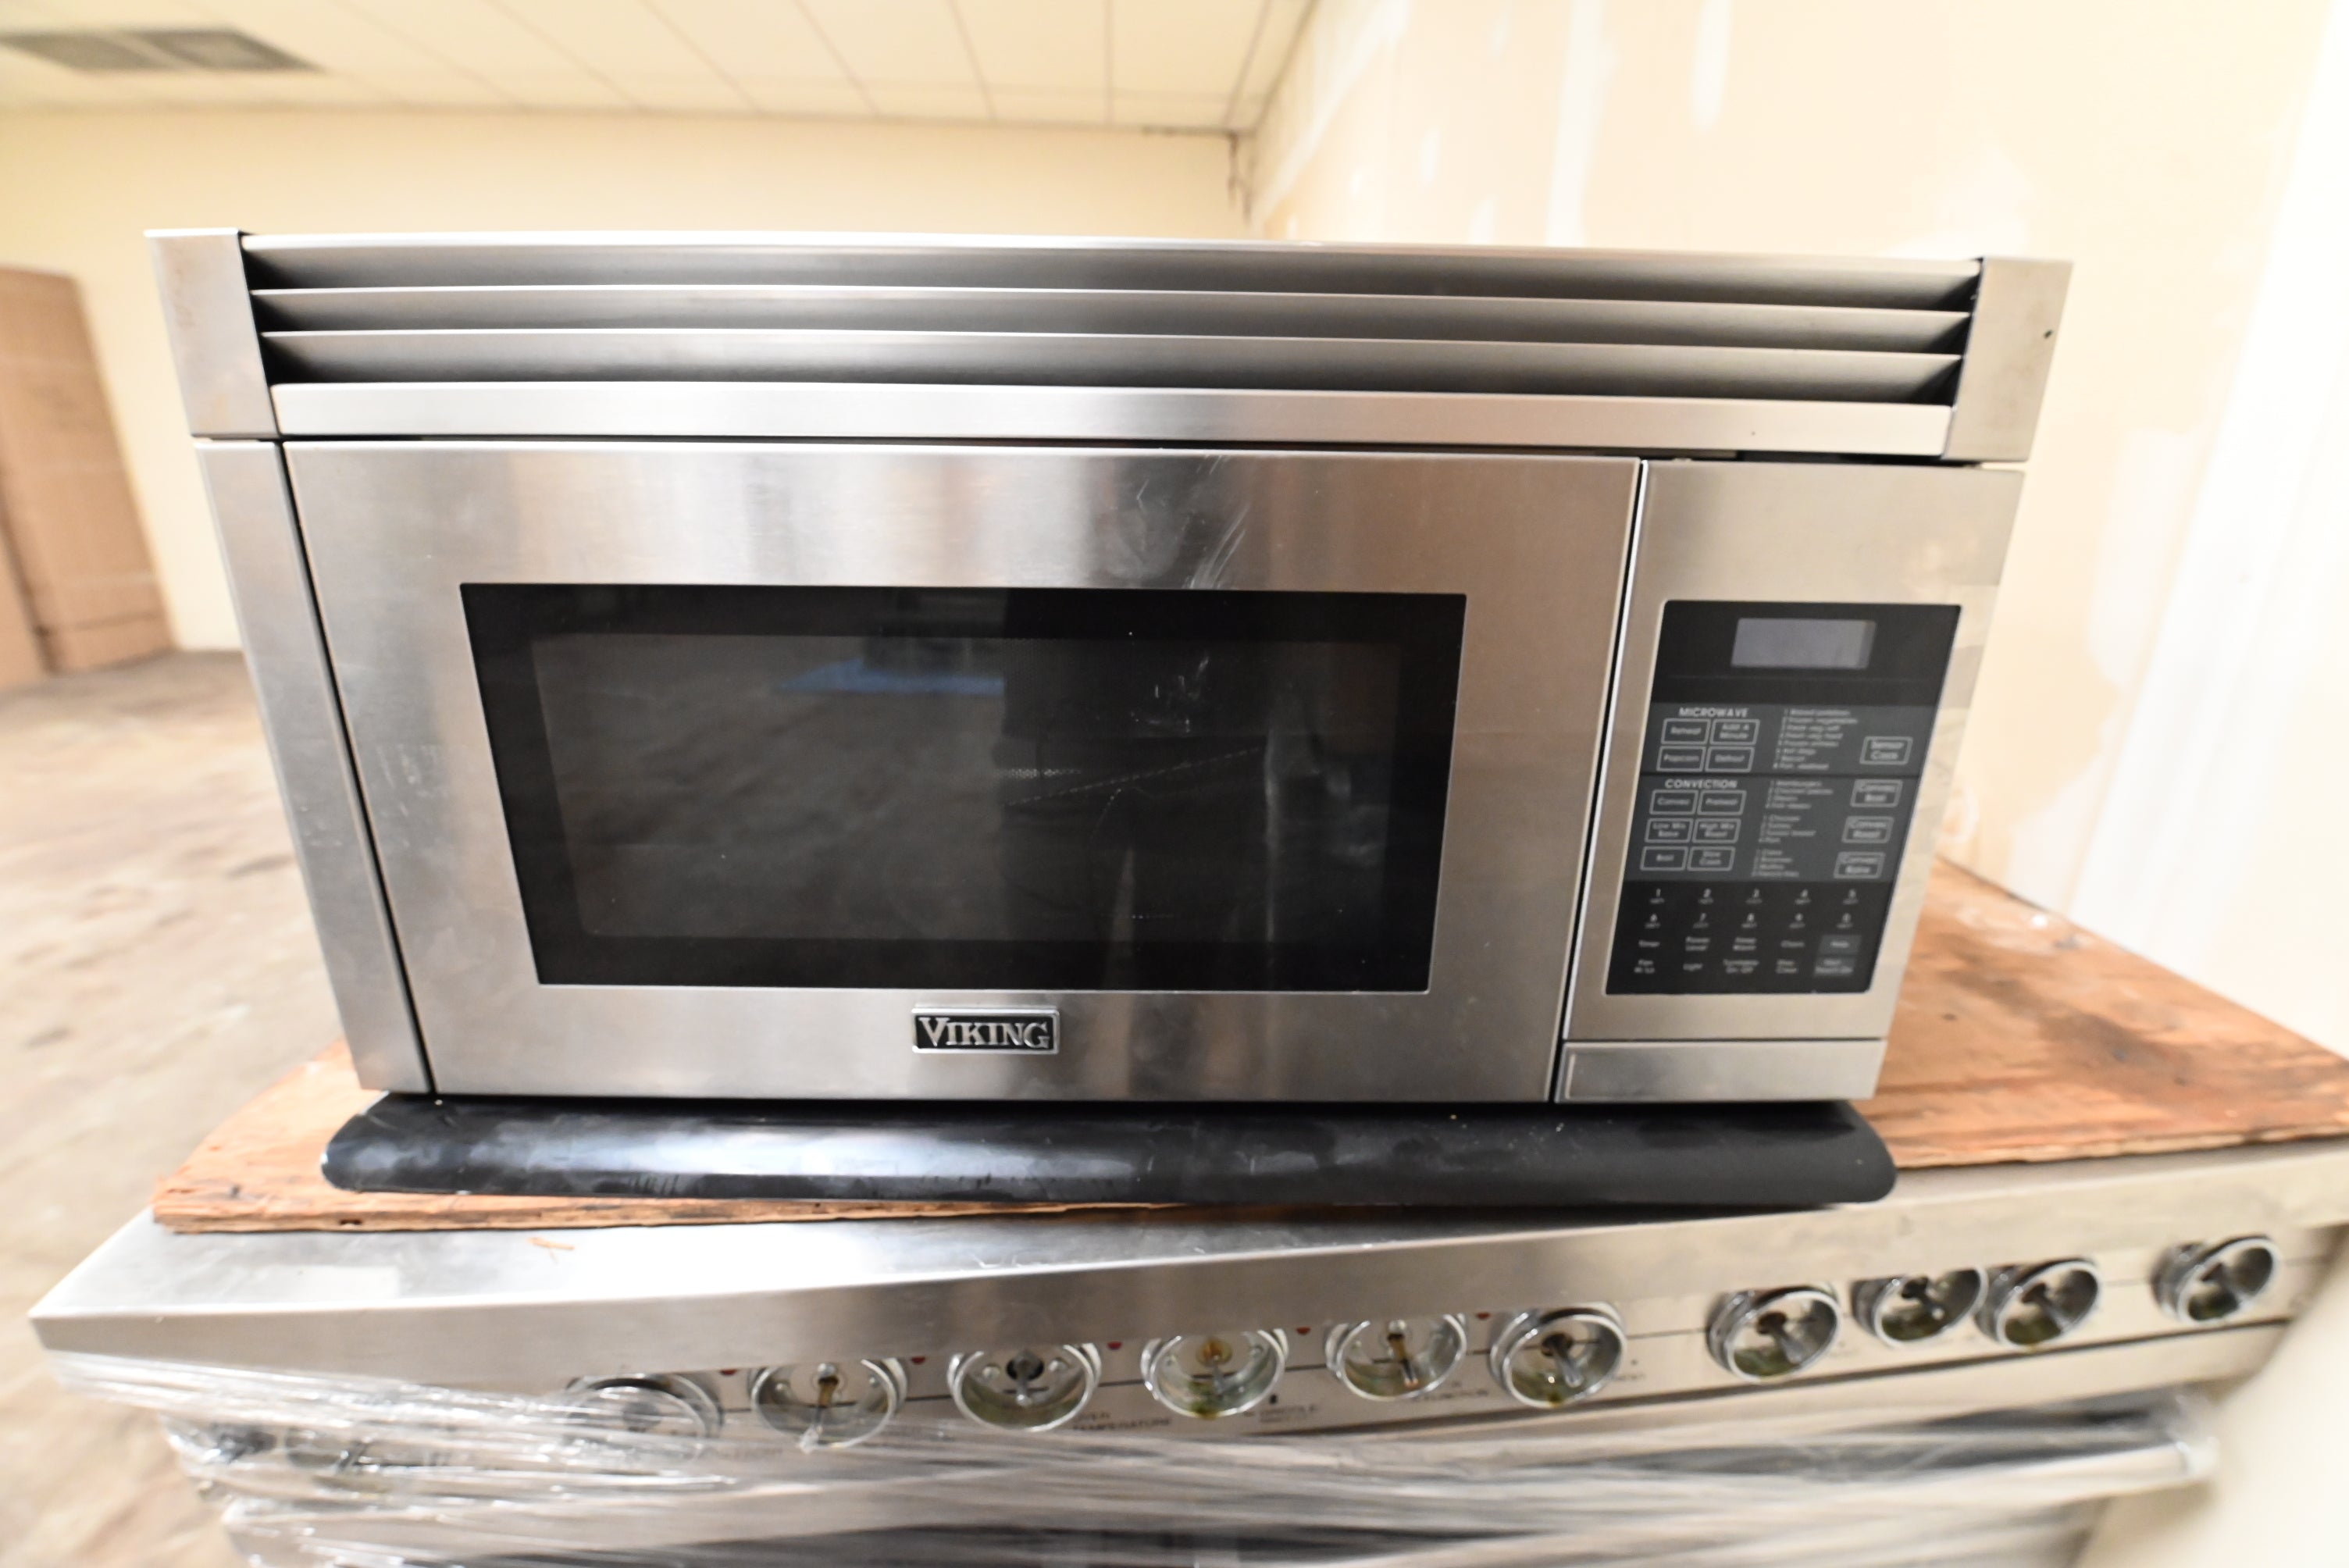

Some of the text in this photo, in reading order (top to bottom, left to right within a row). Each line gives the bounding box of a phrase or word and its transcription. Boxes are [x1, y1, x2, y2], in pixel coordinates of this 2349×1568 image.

[1679, 707, 1748, 717] MICROWAVE
[1665, 779, 1738, 789] CONVECTION
[918, 1017, 1050, 1049] VIKING
